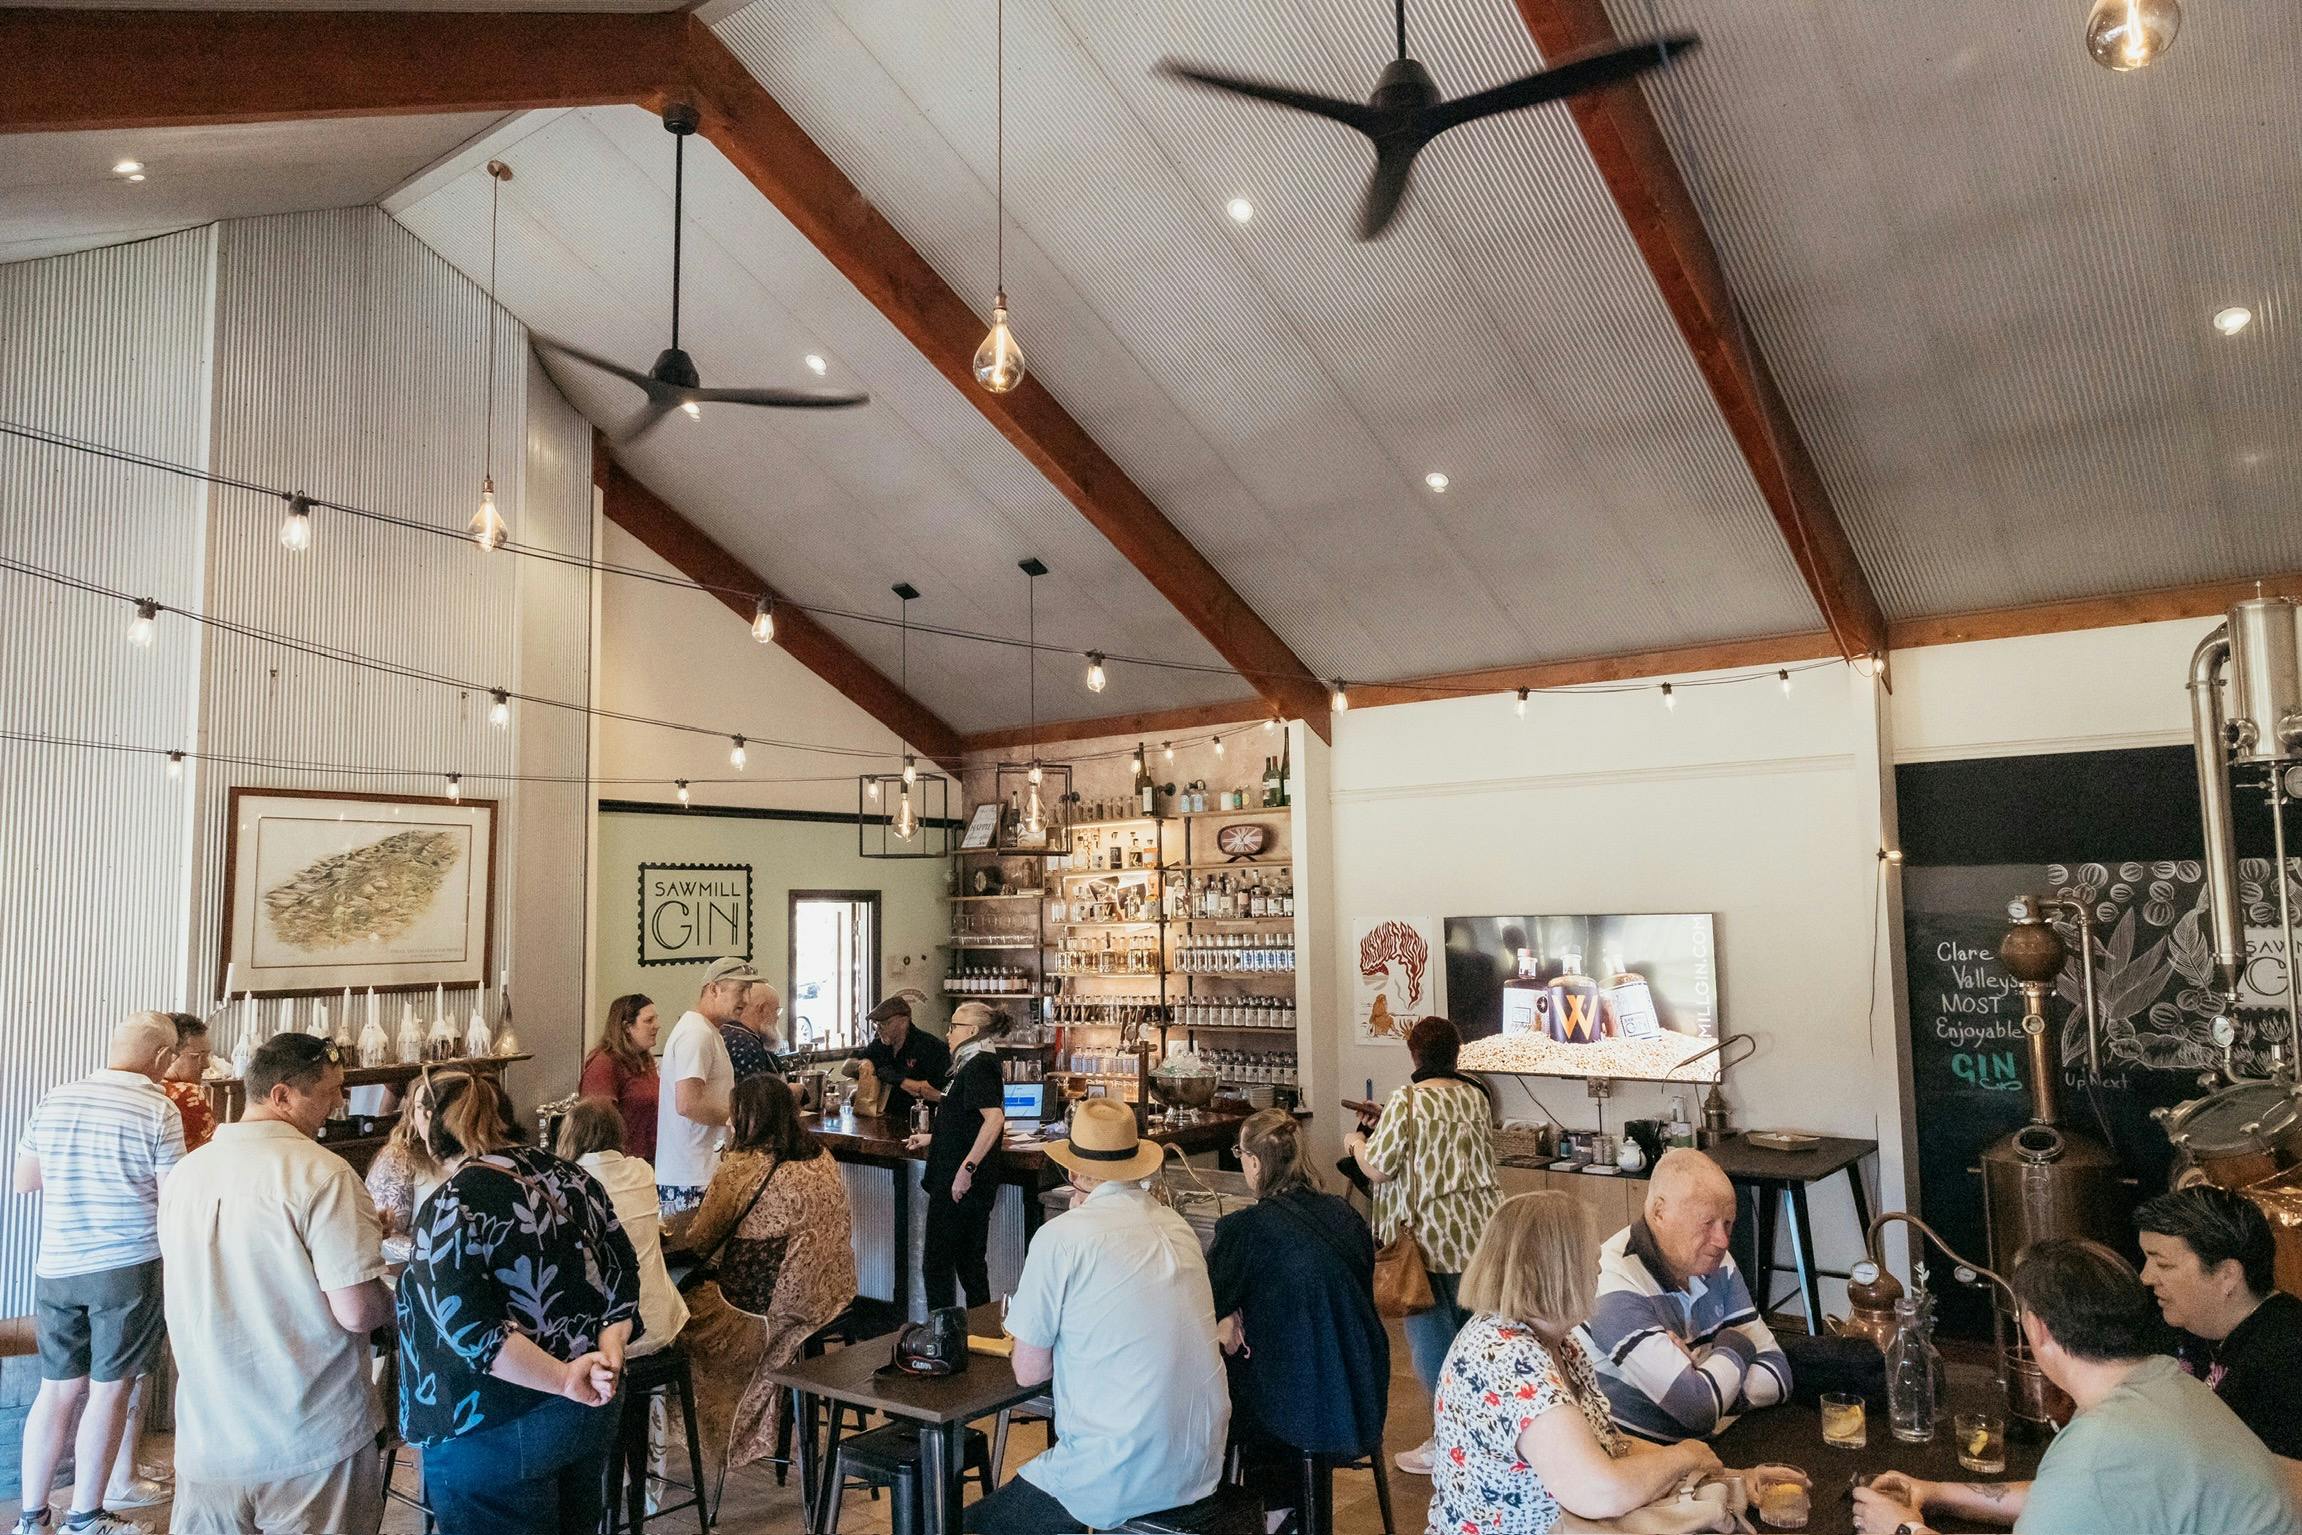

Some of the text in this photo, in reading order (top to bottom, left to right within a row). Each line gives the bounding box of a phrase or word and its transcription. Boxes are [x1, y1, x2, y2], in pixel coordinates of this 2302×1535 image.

[655, 881, 741, 897] SAWMILL
[651, 900, 739, 950] GIN
[1937, 941, 1994, 961] Clare
[1551, 994, 1598, 1040] W
[1941, 993, 2001, 1014] MOST
[1936, 1016, 2025, 1048] Enjoyable
[1951, 1051, 2016, 1087] GIN
